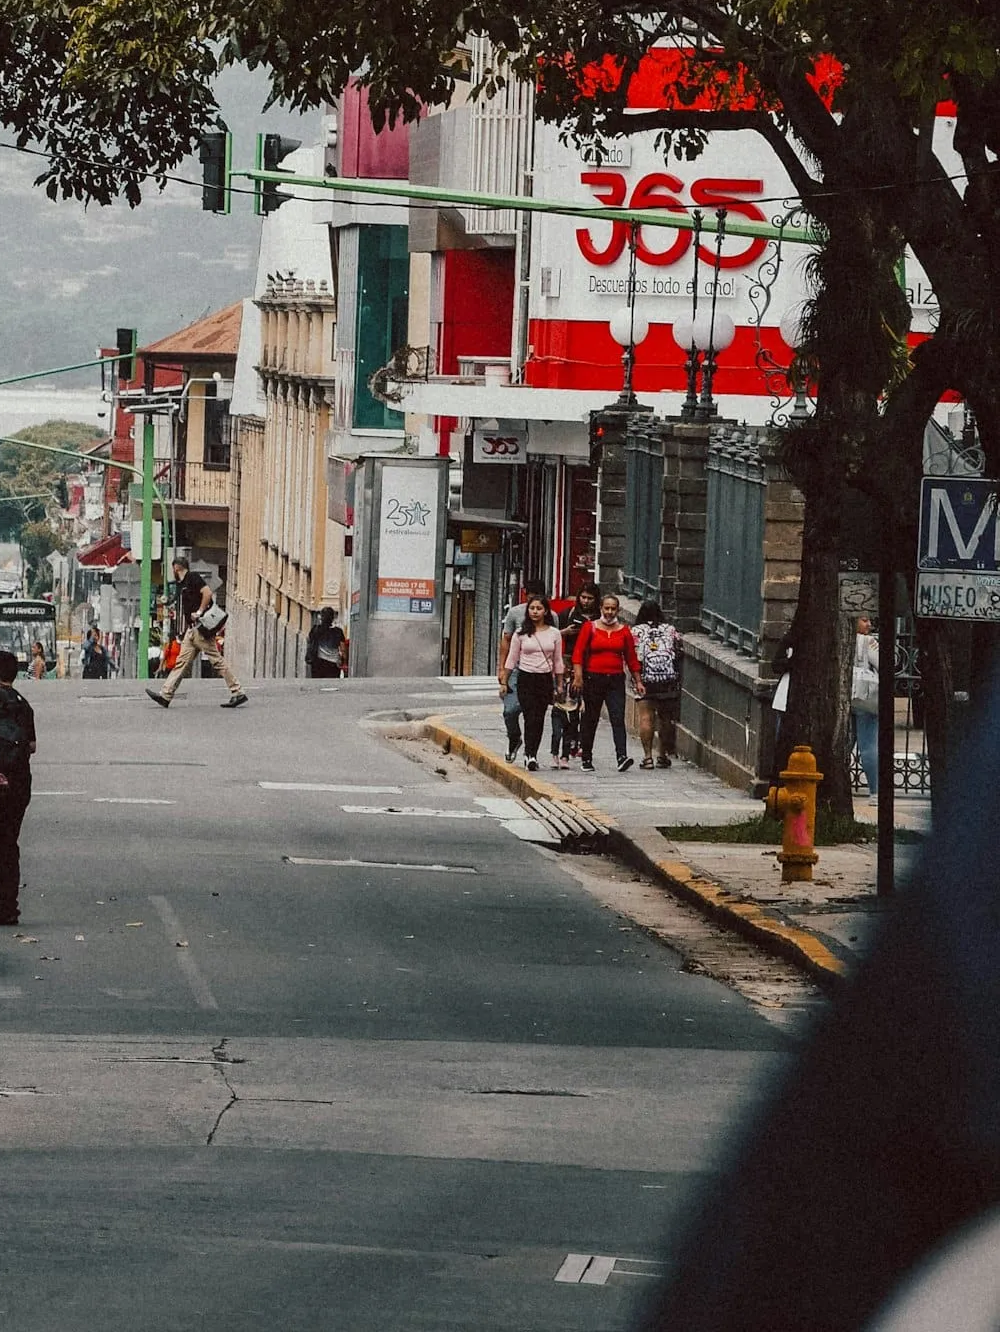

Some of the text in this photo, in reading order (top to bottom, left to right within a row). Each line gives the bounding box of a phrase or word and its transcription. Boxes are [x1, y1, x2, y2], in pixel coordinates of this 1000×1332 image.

[576, 172, 768, 270] 365
[652, 277, 680, 294] todo
[482, 437, 520, 455] 365
[920, 585, 977, 608] MUSEO
